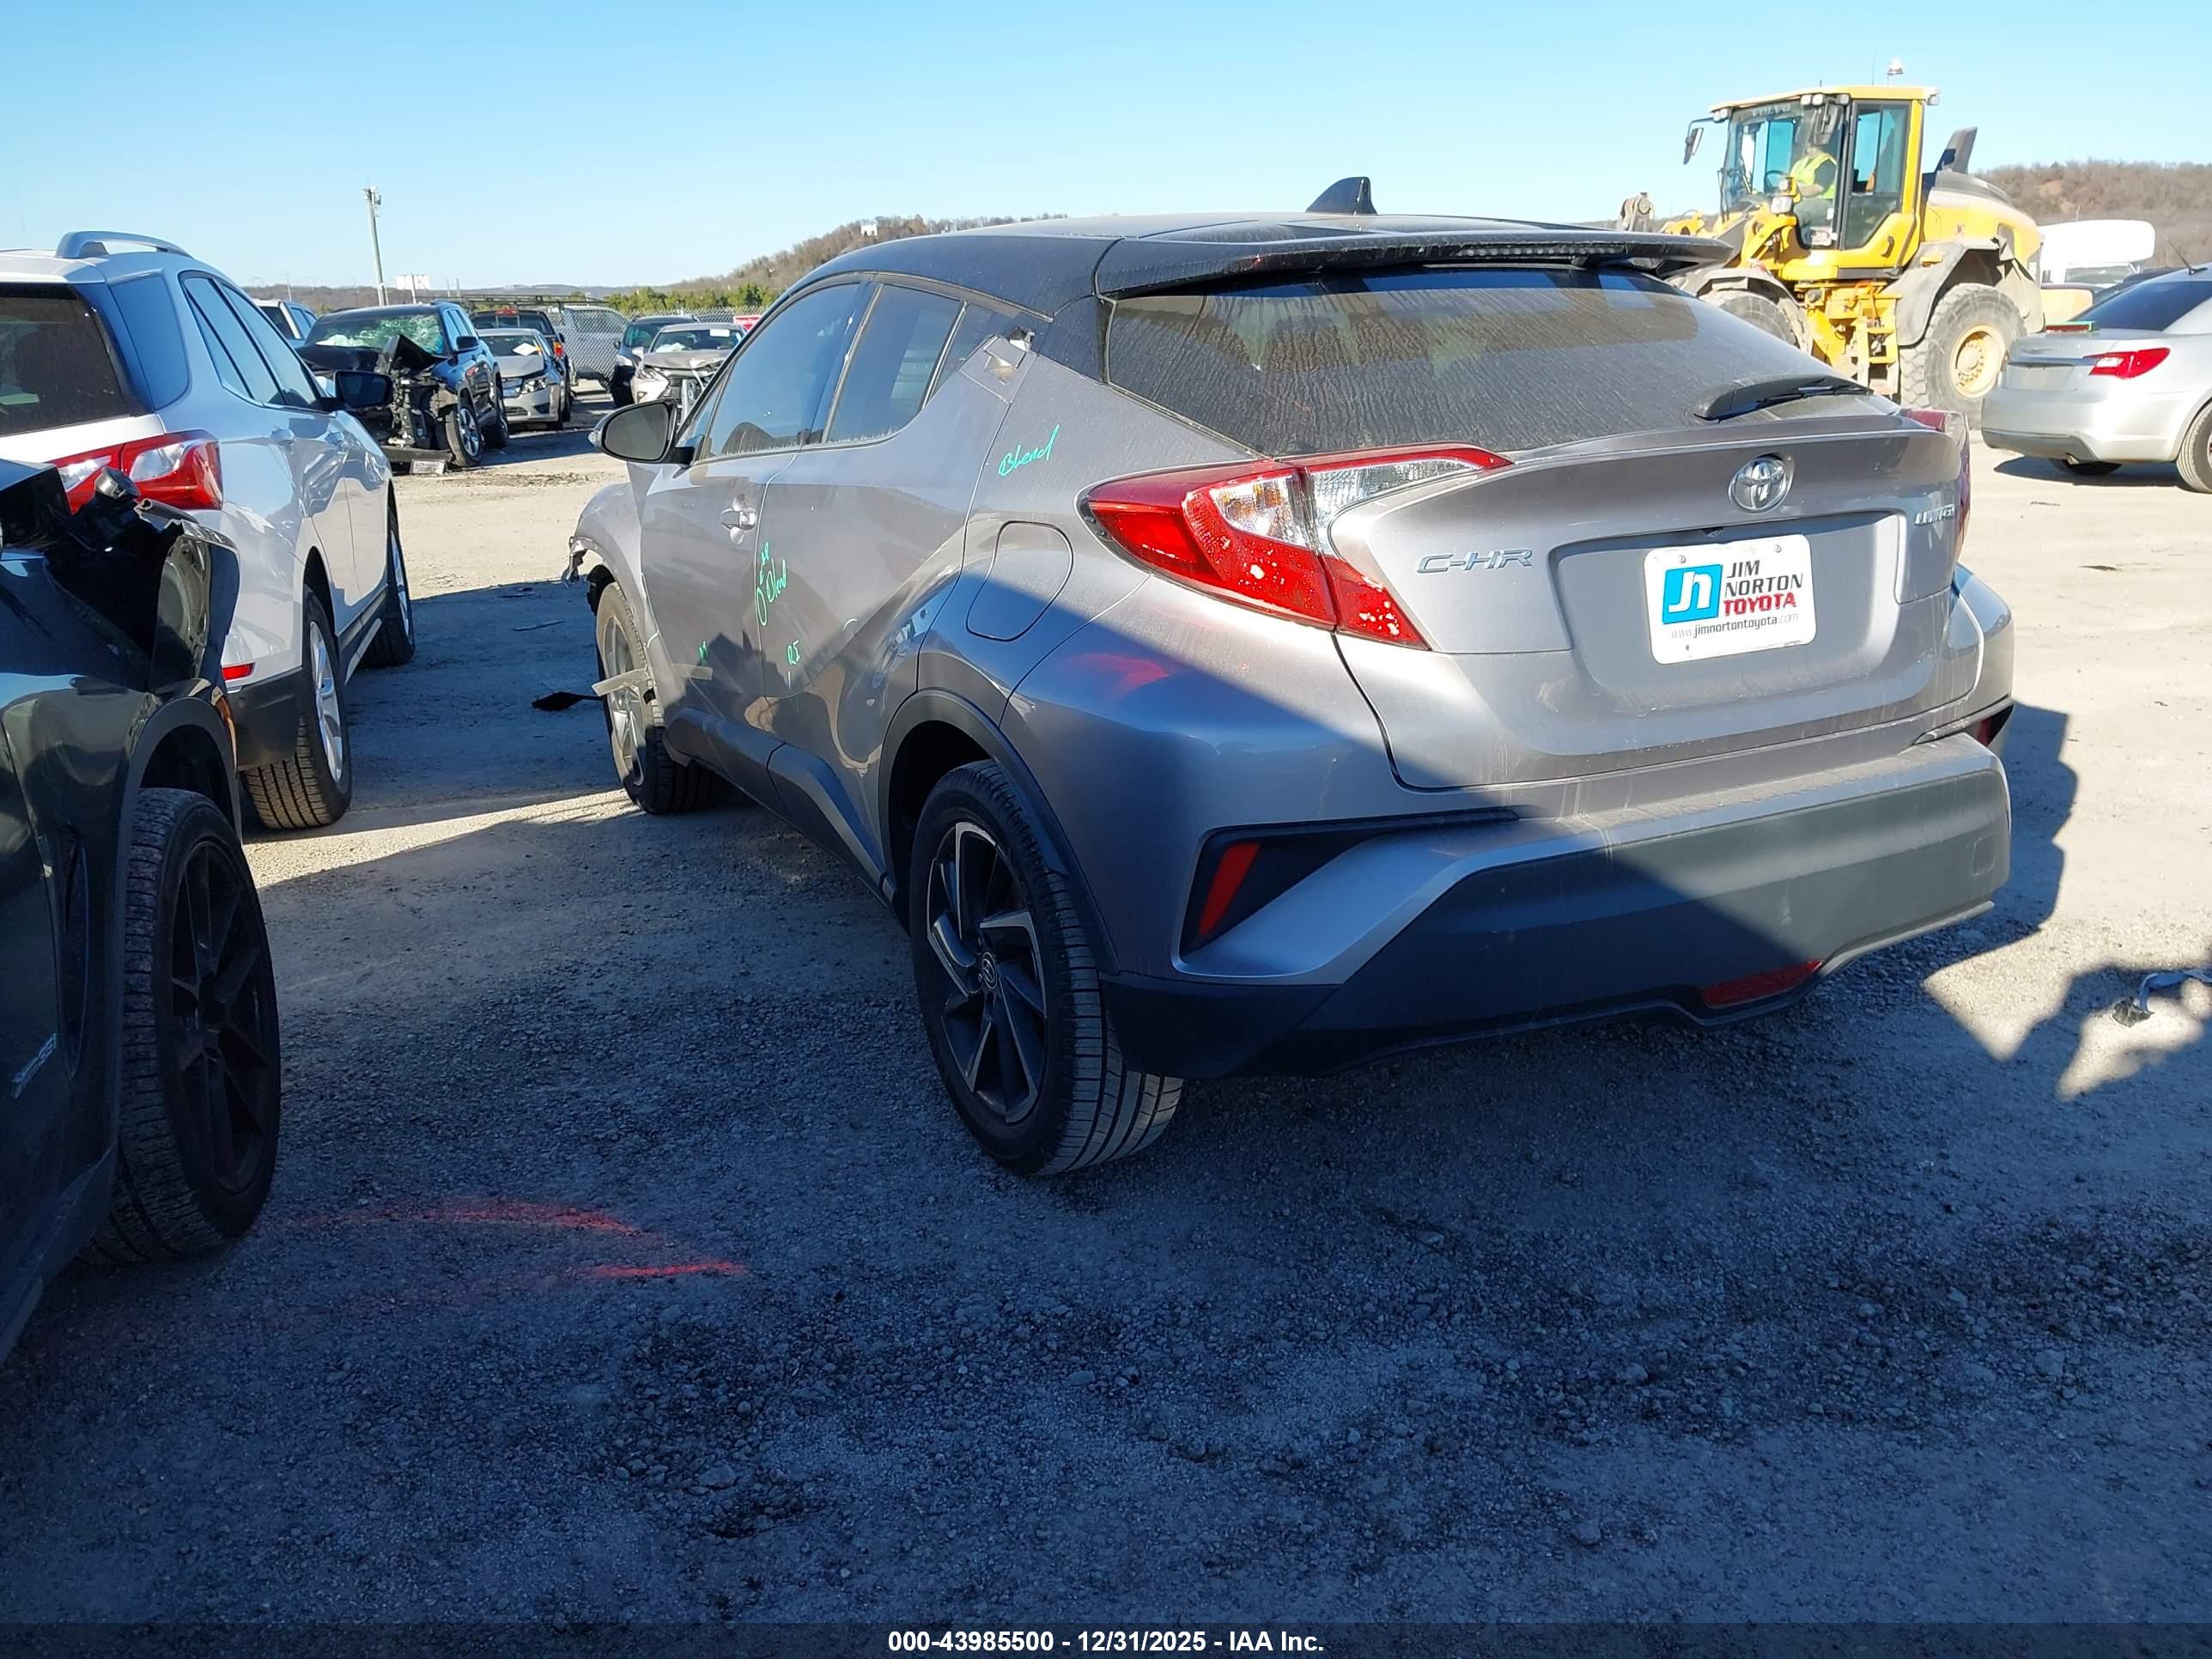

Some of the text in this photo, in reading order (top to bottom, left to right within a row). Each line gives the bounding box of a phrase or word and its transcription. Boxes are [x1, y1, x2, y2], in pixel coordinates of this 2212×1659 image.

[1417, 548, 1533, 574] C-HR
[1727, 560, 1760, 578] JIM
[1724, 573, 1803, 598] NORTON
[1723, 592, 1797, 617] TOYOTA
